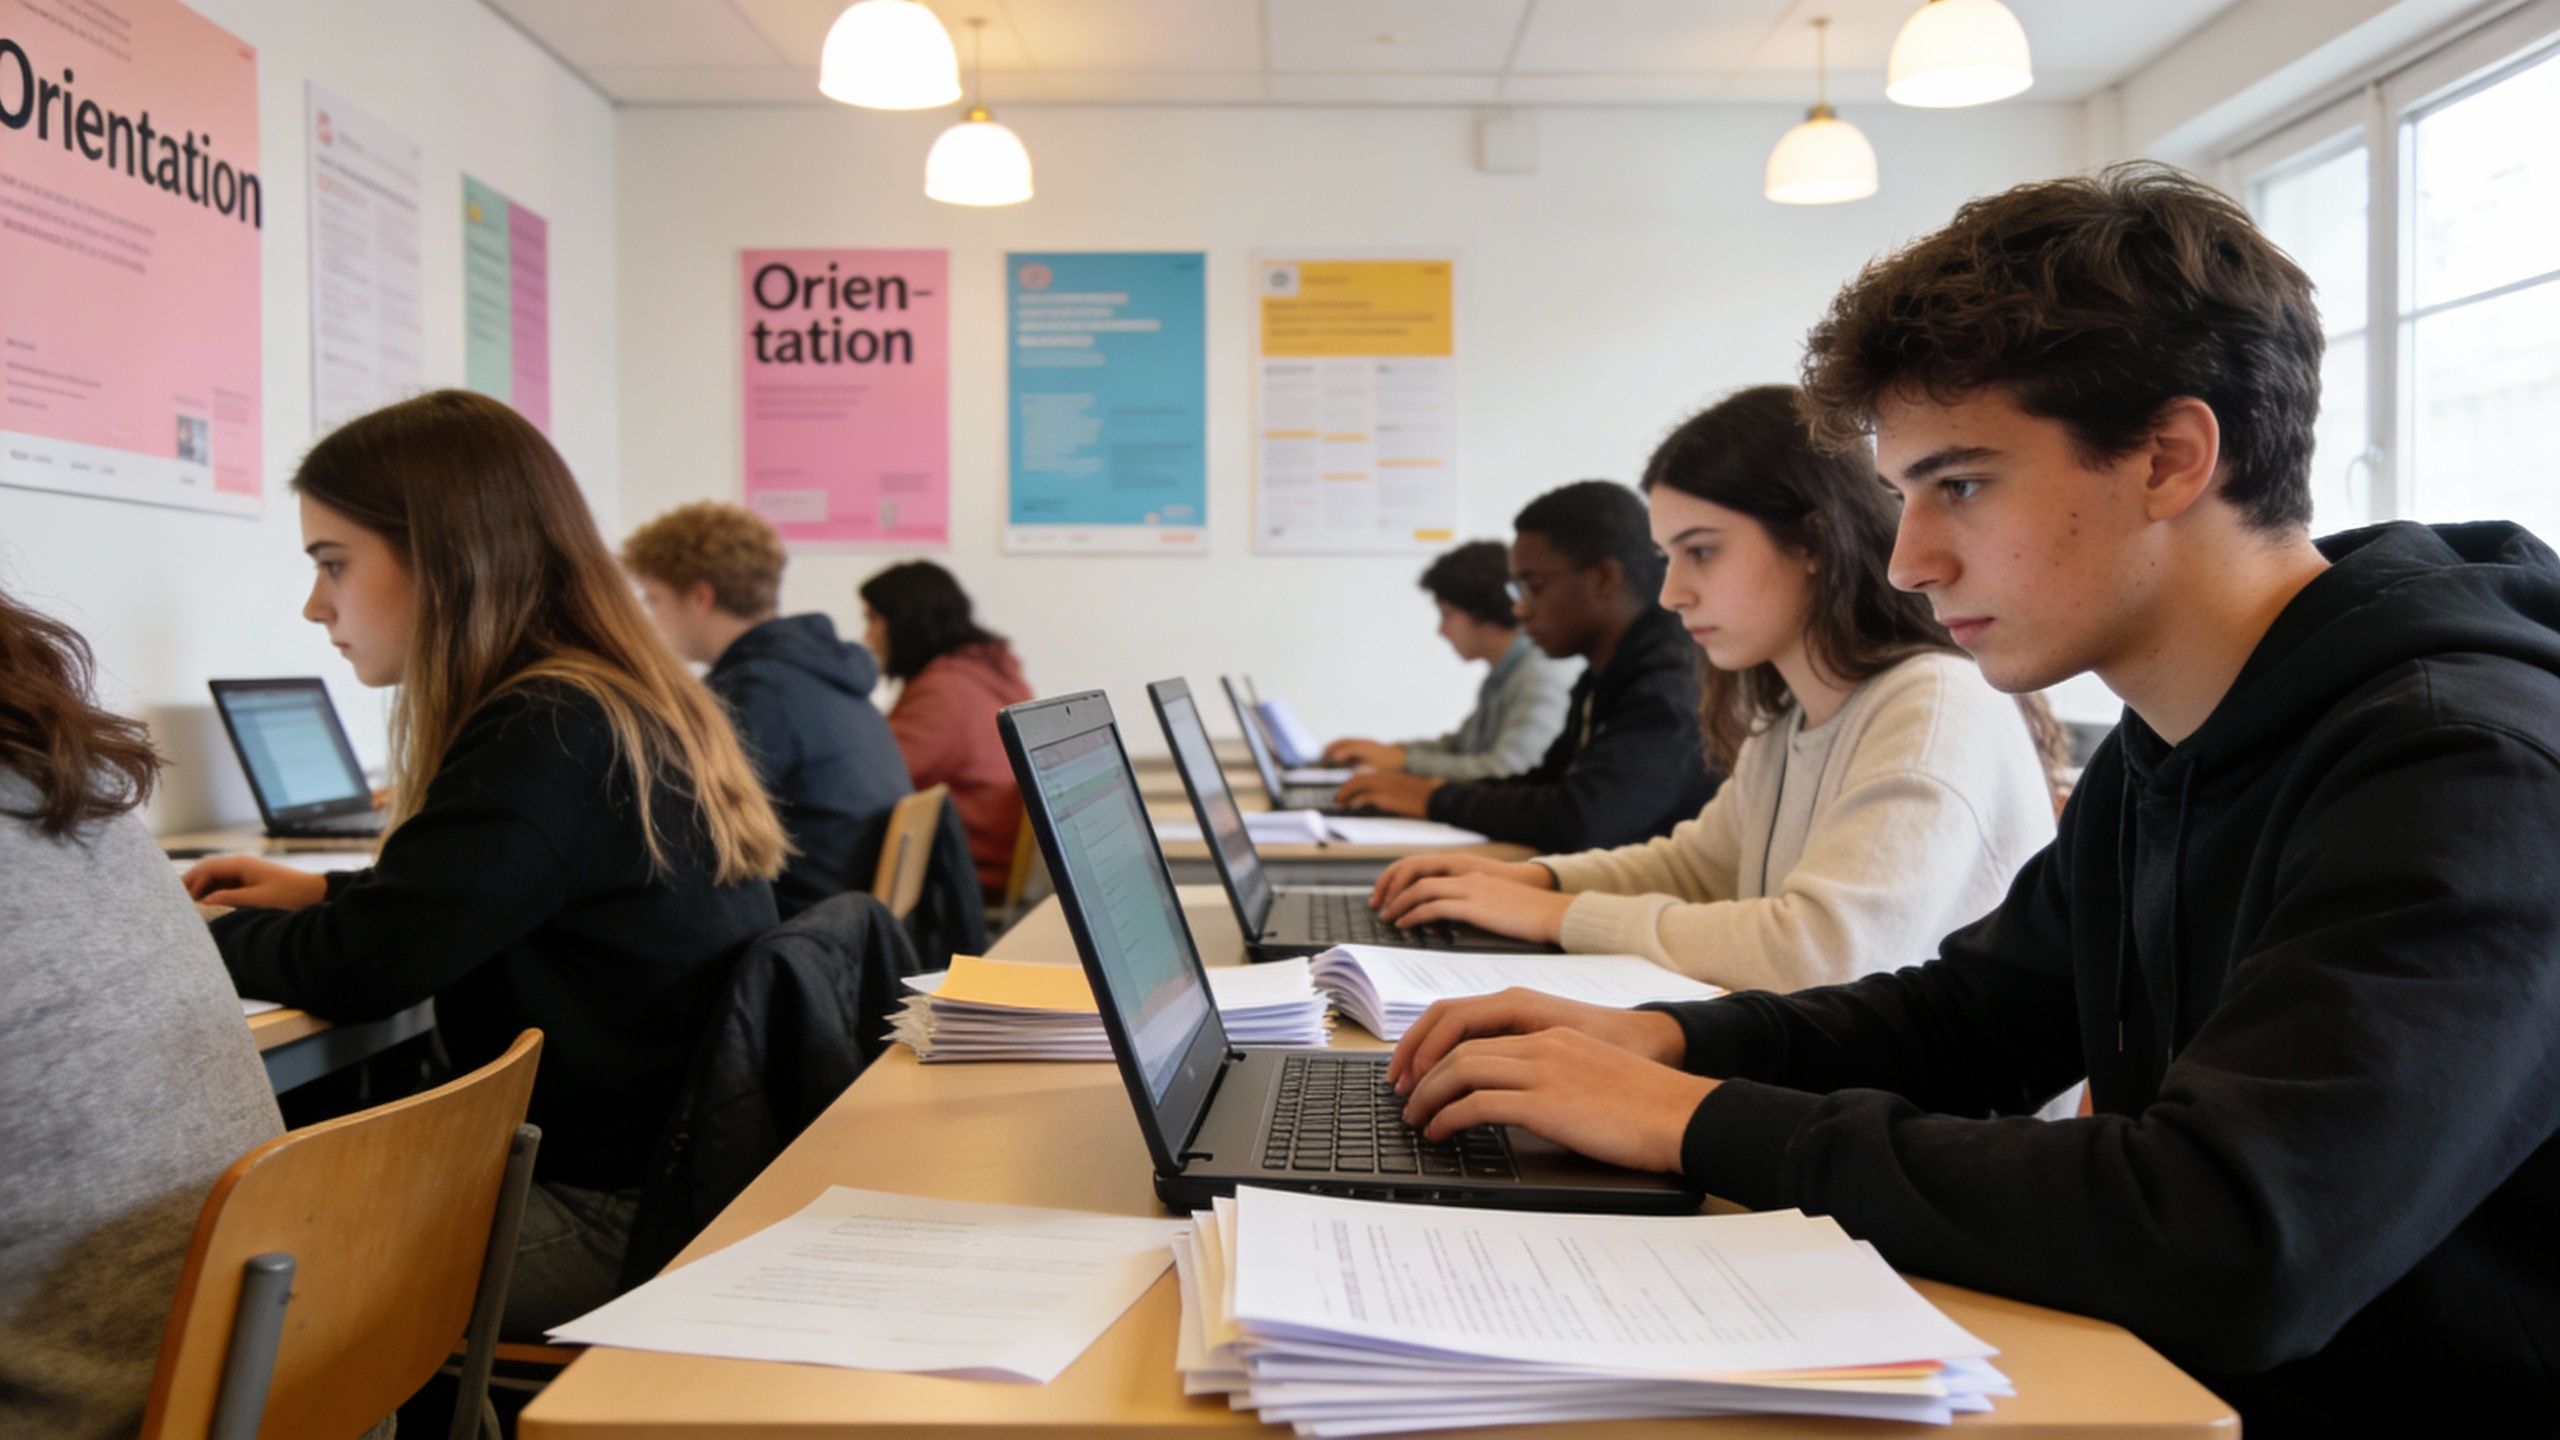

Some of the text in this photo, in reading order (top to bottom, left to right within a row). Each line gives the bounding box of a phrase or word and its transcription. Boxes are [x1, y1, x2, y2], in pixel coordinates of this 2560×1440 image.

[0, 38, 262, 229] Orientation
[753, 262, 933, 310] Orien-
[752, 317, 914, 365] tation
